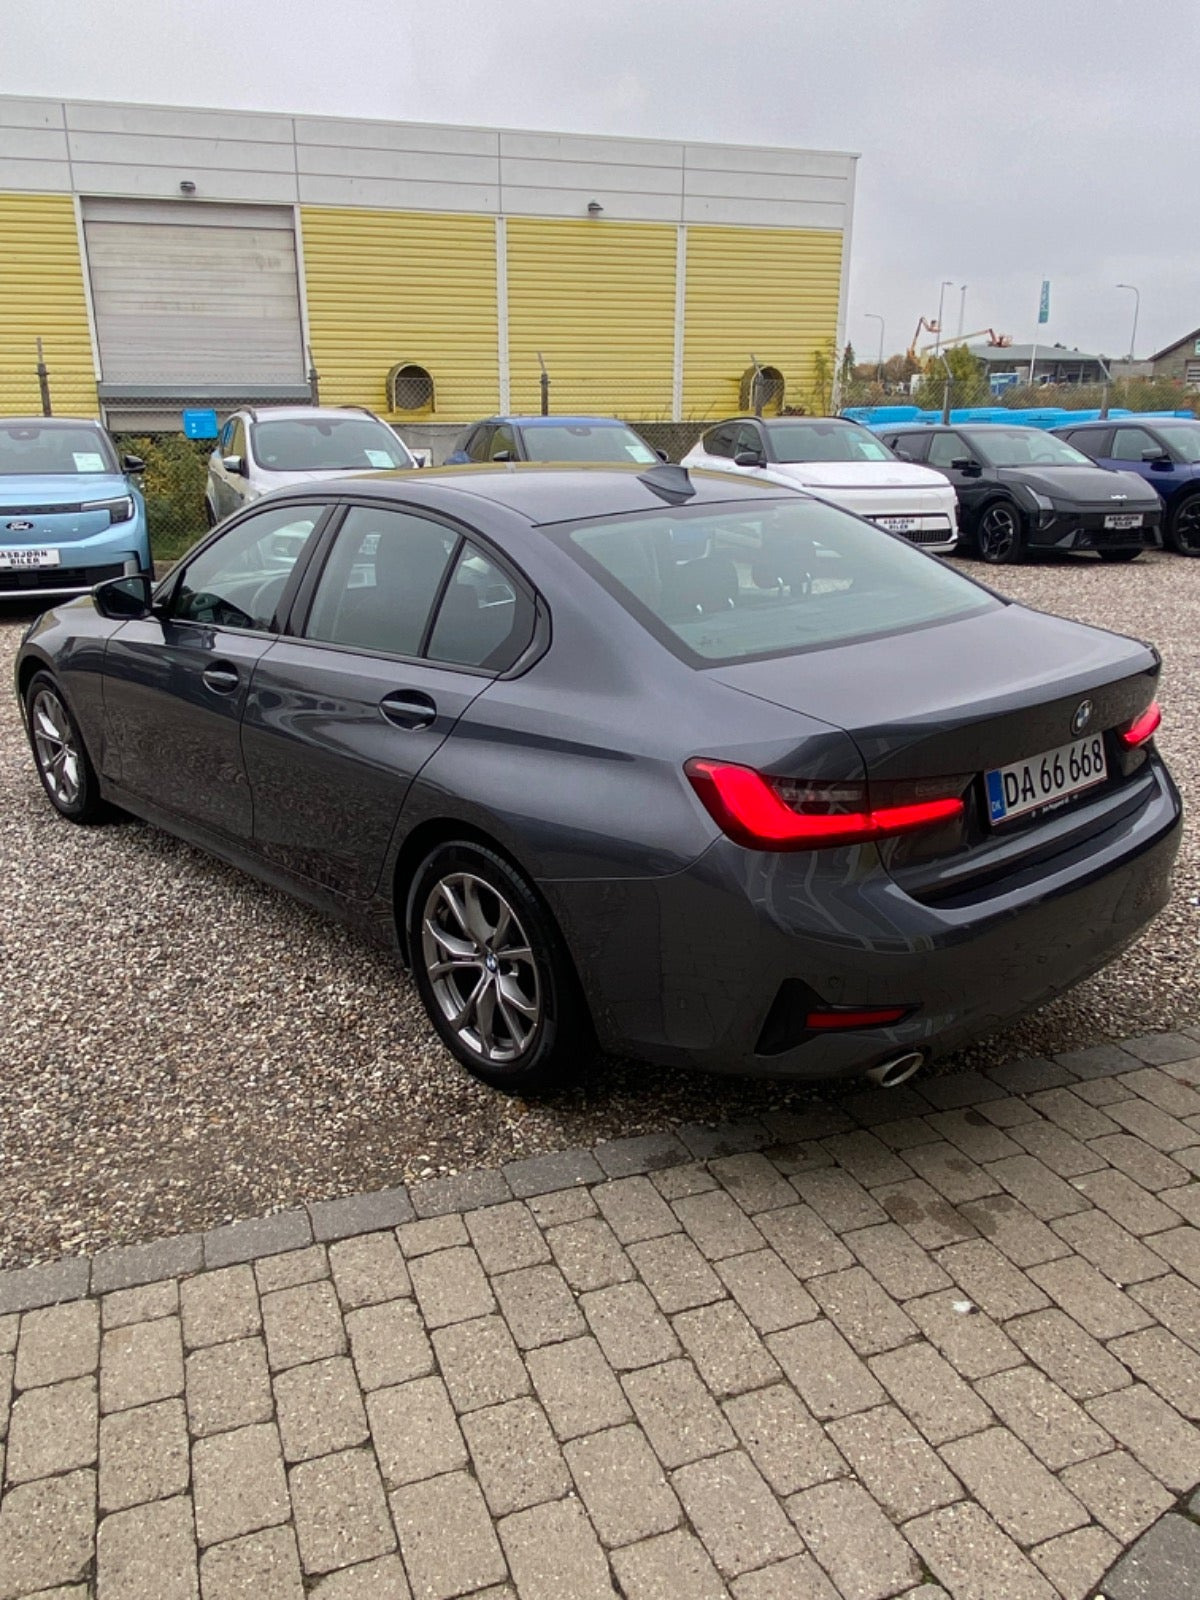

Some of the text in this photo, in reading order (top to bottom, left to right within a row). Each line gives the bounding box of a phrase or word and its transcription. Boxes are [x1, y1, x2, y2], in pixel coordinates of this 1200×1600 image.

[9, 522, 30, 530] Ford
[1003, 740, 1103, 808] DA 66 668
[992, 801, 1002, 812] DK
